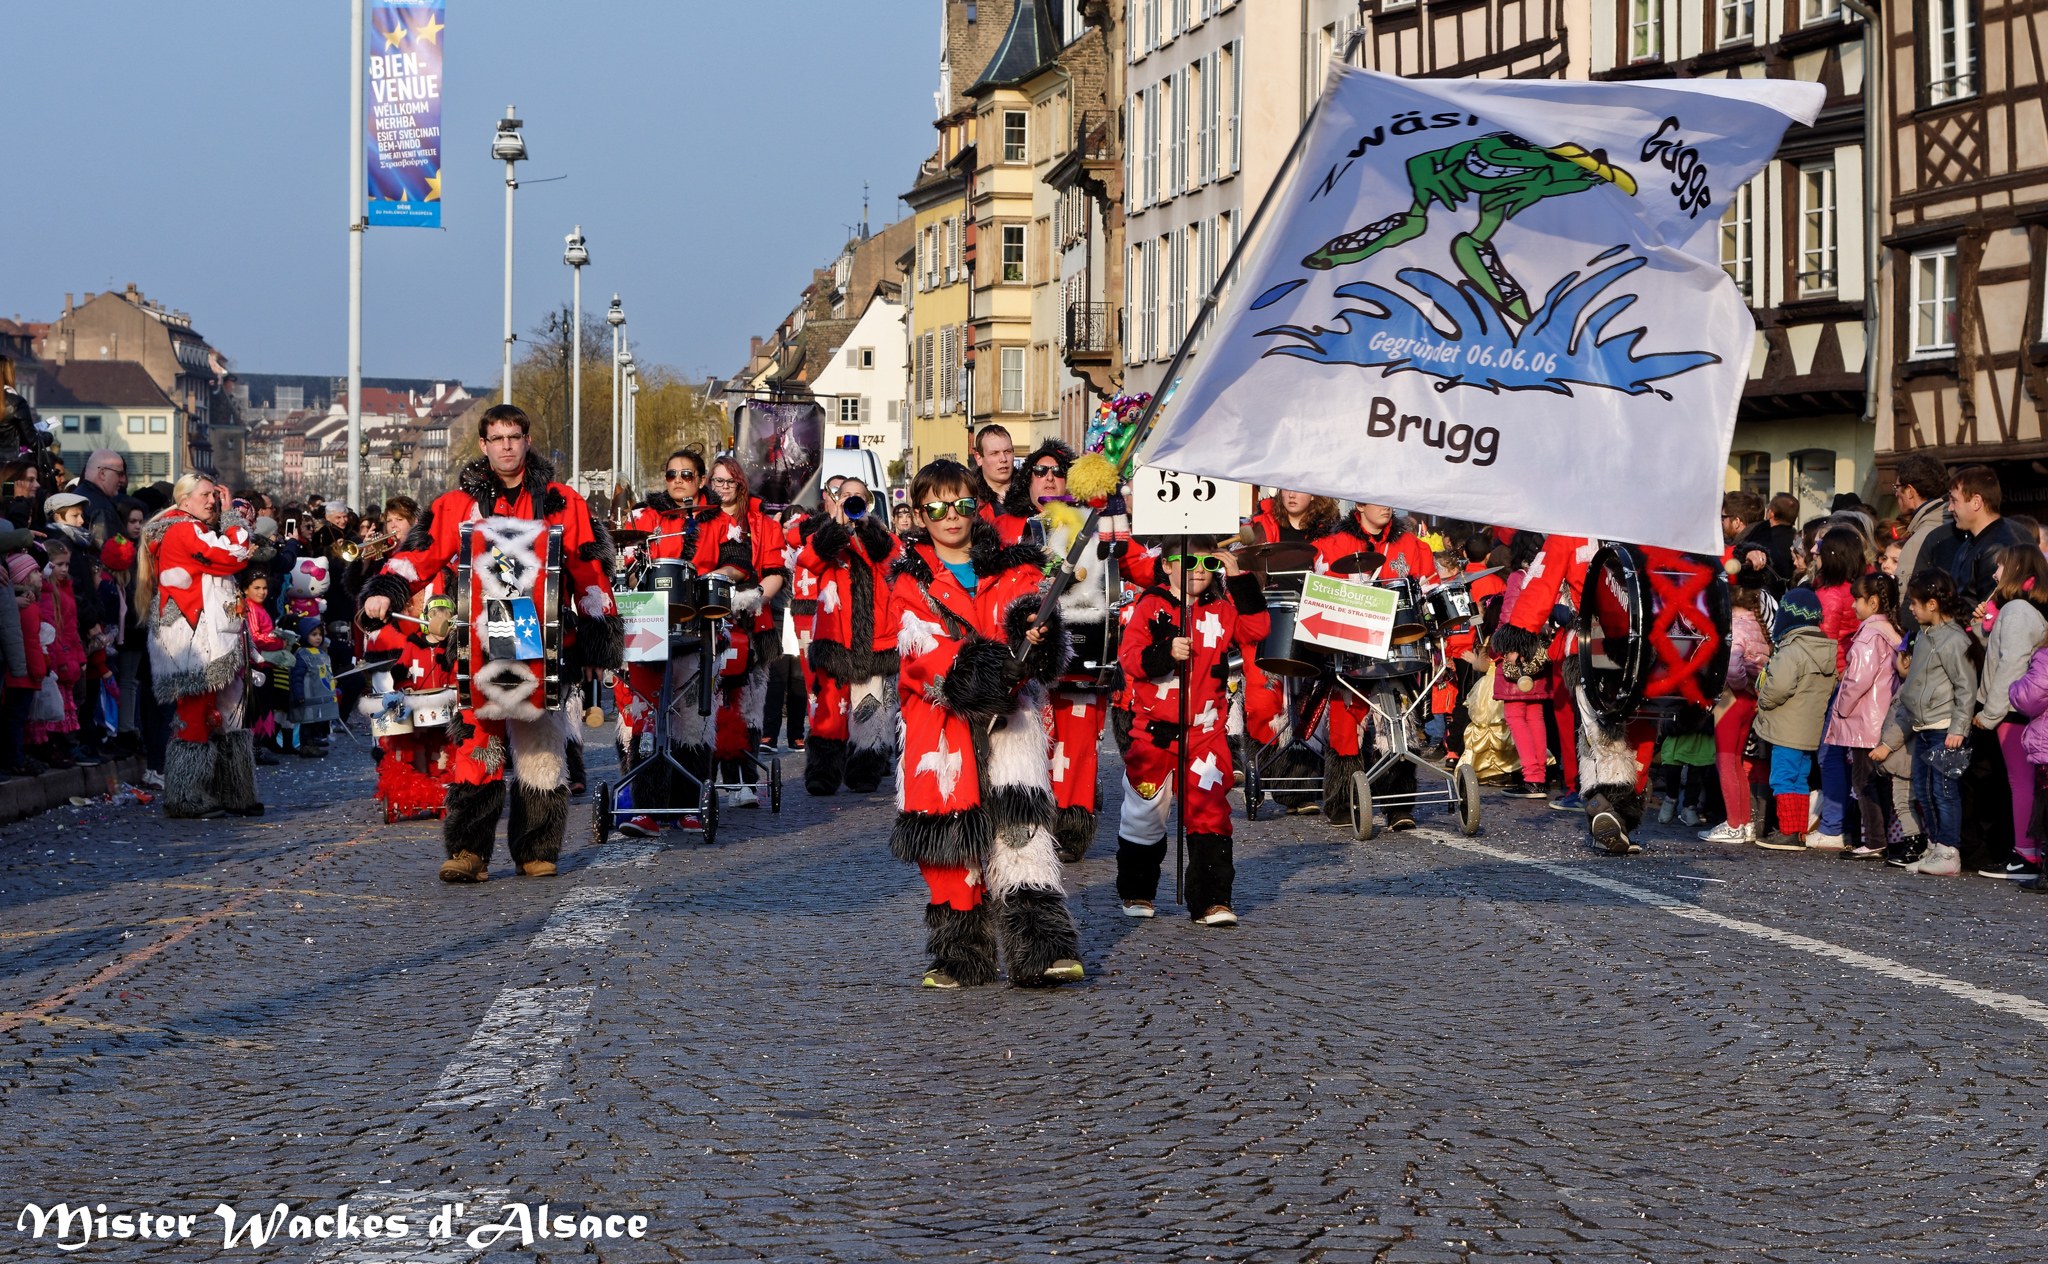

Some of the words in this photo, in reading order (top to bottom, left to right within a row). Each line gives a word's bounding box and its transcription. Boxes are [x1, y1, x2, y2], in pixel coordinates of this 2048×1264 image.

[371, 52, 427, 80] BIEN-
[371, 74, 439, 103] VENUE
[373, 101, 430, 118] WËLLKOMM
[375, 115, 417, 131] MERHBA
[377, 130, 398, 142] ESIET
[399, 127, 440, 140] SVEICINATI
[378, 138, 421, 152] BEM-VINDO
[1369, 331, 1461, 362] Gegründet
[1466, 344, 1558, 374] 06.06.06
[861, 434, 886, 447] 1741
[1367, 396, 1500, 467] Brugg
[1303, 599, 1336, 612] CARNAVAL
[1337, 606, 1347, 614] DE
[1347, 608, 1391, 622] STRASBOURG
